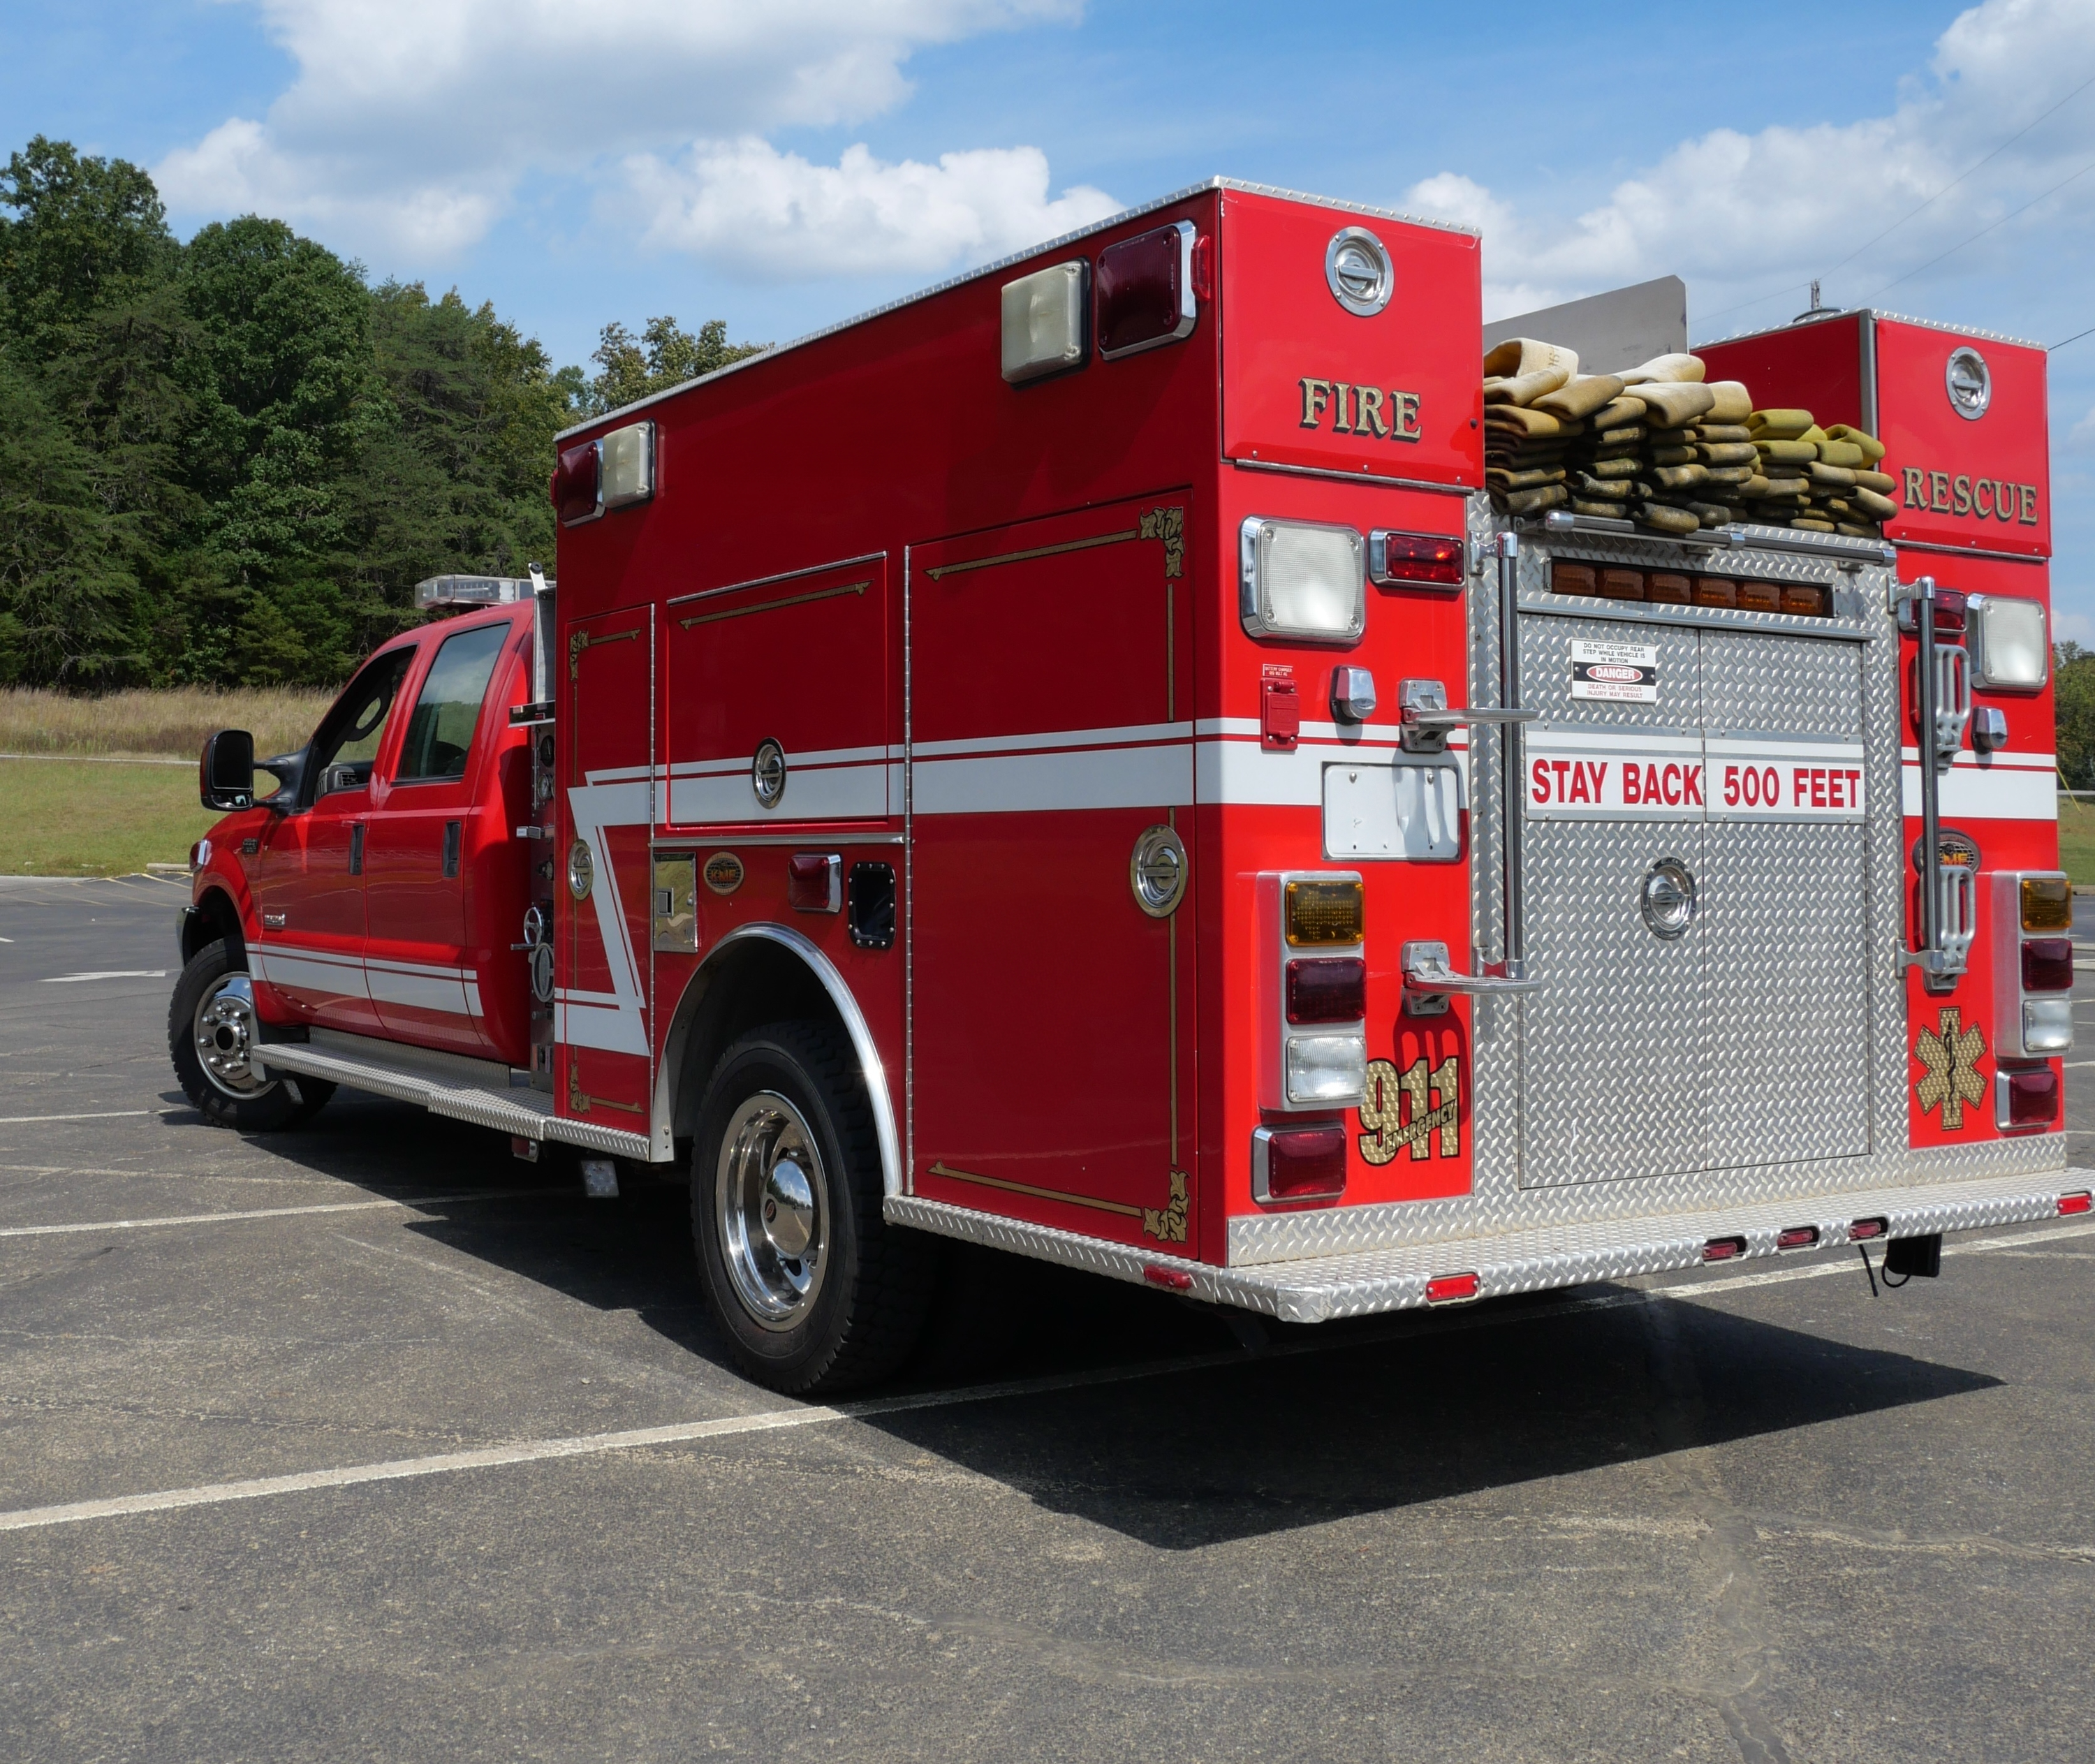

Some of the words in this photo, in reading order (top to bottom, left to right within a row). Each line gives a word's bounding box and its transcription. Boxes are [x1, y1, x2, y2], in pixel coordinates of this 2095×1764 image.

[1298, 377, 1422, 443] FIRE
[1902, 466, 2038, 525] RESCUE
[1596, 668, 1635, 679] DANGER
[1531, 759, 1608, 804] STAY
[1622, 763, 1703, 806] BACK
[1724, 765, 1780, 808] 500
[1793, 767, 1861, 809] FEET
[711, 869, 737, 881] KME
[1358, 1055, 1460, 1166] 911
[1385, 1098, 1456, 1155] EMERGENCY
